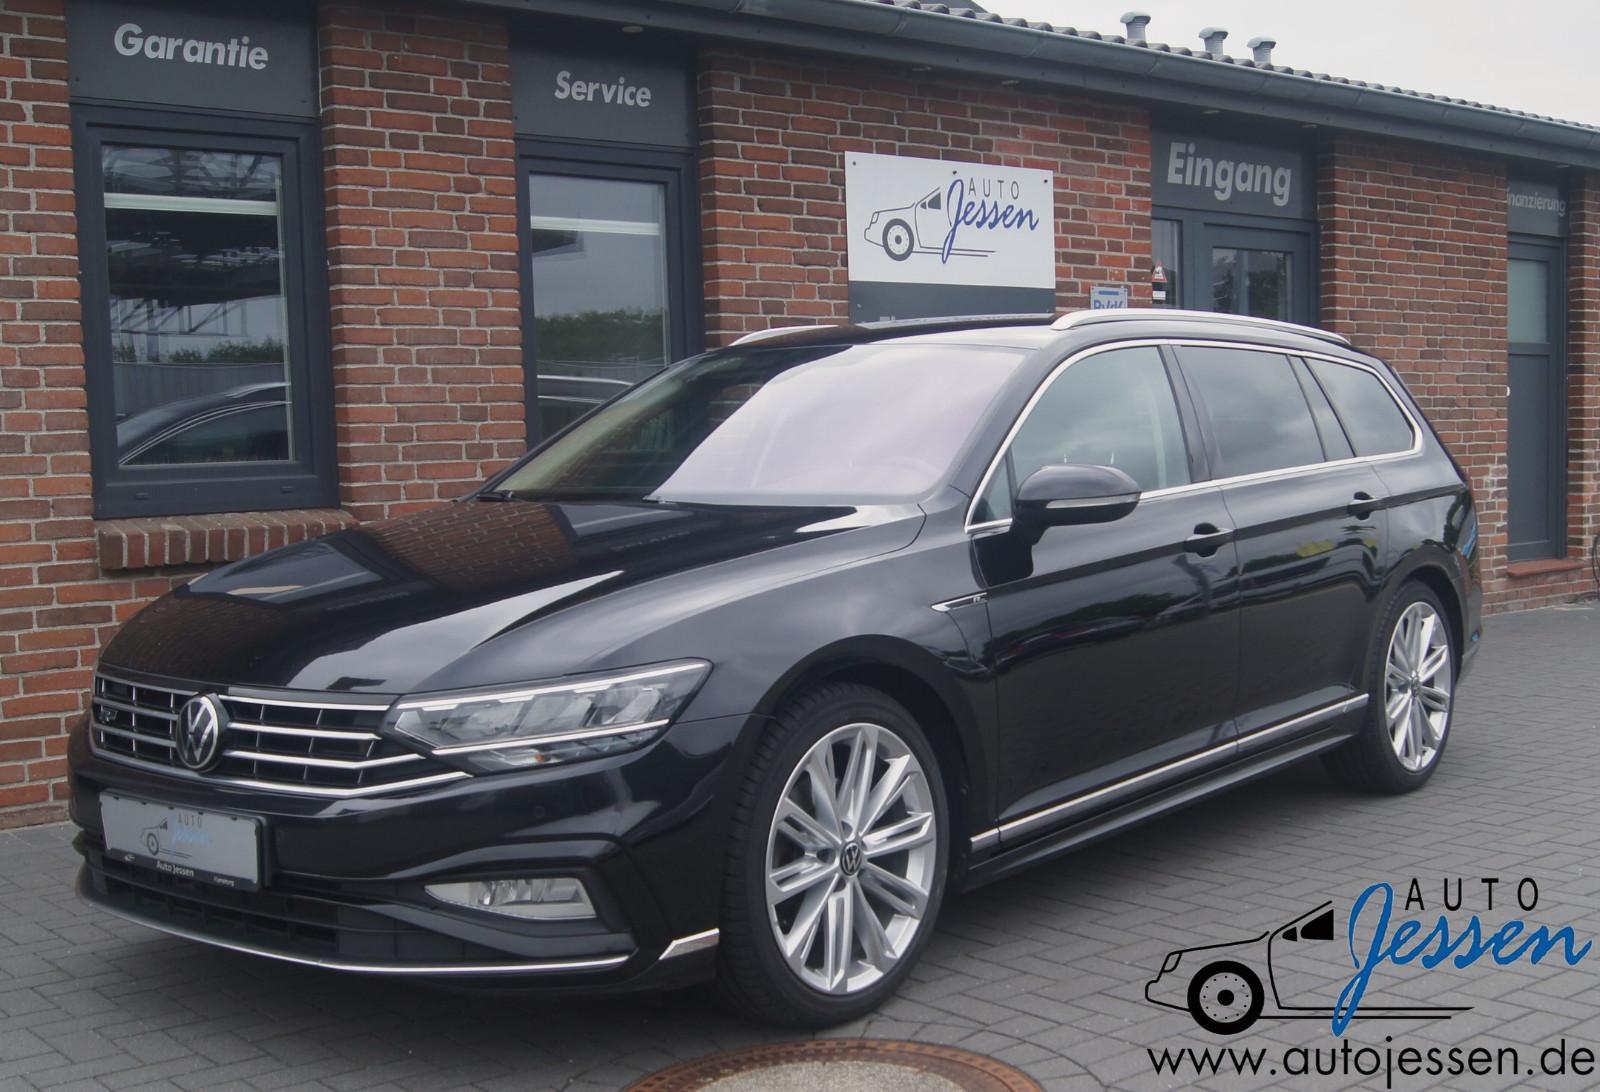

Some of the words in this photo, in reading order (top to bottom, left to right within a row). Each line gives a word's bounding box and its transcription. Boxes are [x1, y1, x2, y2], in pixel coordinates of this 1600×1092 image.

[113, 23, 270, 71] Garantie
[553, 70, 652, 108] Service
[967, 177, 1020, 200] AUTO
[1167, 142, 1292, 207] Eingang
[941, 178, 1040, 265] Jessen
[1507, 192, 1567, 216] nanzierung
